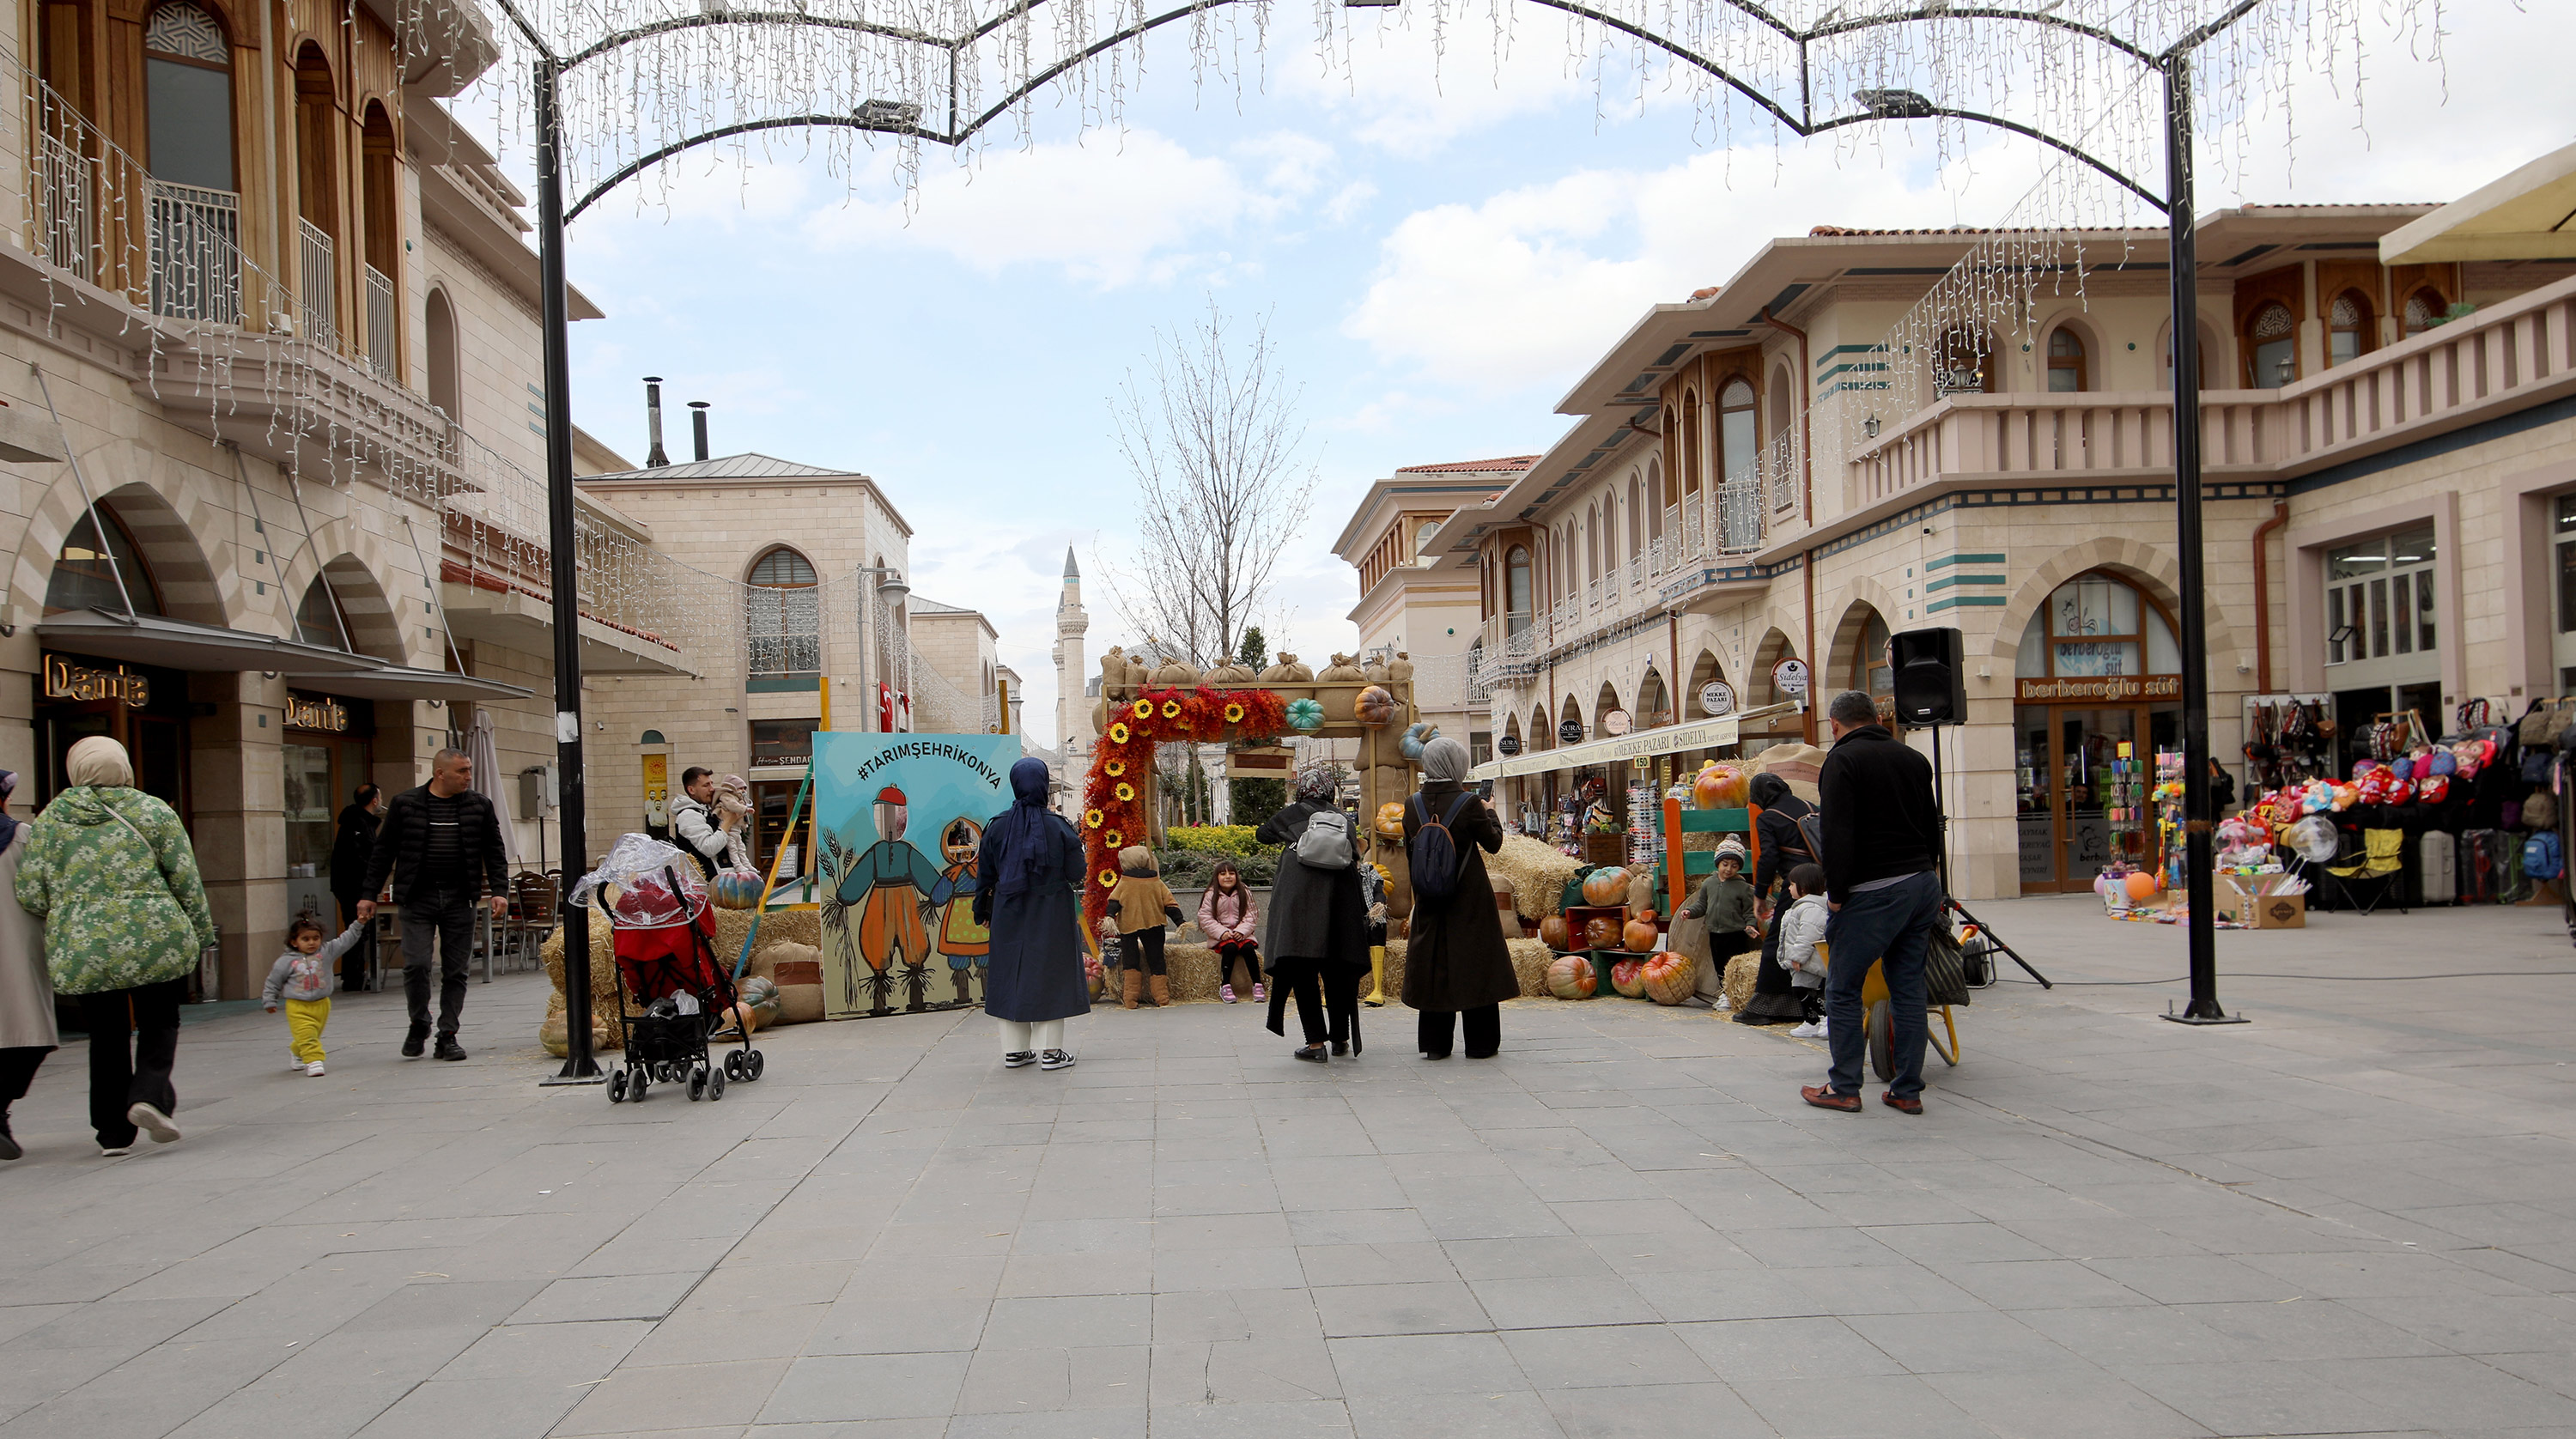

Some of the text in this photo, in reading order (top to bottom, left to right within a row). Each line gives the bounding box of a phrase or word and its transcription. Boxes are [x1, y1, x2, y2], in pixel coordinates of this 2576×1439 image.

[1935, 370, 1982, 387] SUA
[45, 654, 149, 707] Damla
[2023, 677, 2179, 701] berberoğlu süt
[1643, 735, 1669, 753] PAZARI
[858, 741, 1001, 790] #TARIMŞEHRİKONYA
